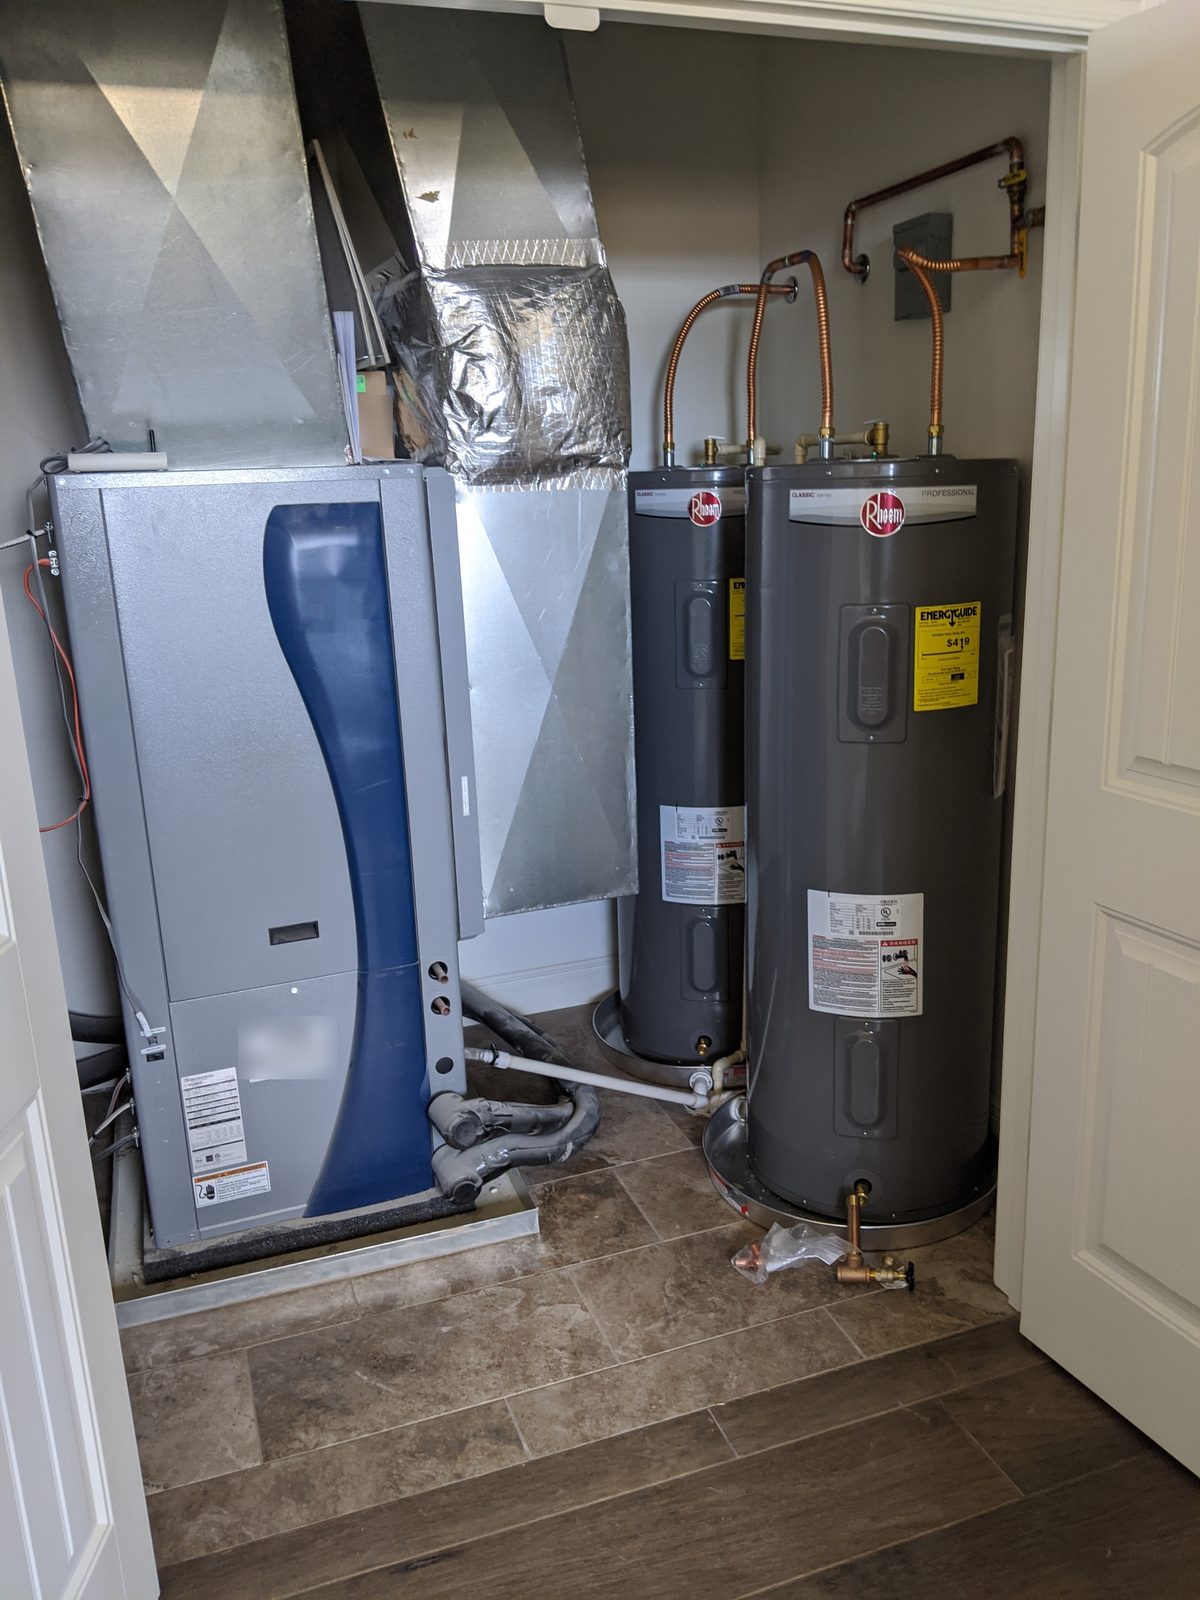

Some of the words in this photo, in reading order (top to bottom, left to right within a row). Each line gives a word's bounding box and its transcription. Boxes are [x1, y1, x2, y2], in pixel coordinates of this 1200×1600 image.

[921, 489, 976, 497] PROFESSIONAL
[691, 491, 720, 521] Rheem
[866, 493, 905, 530] Rheem
[920, 606, 978, 621] ENERGYGUIDE
[946, 637, 970, 648] $419
